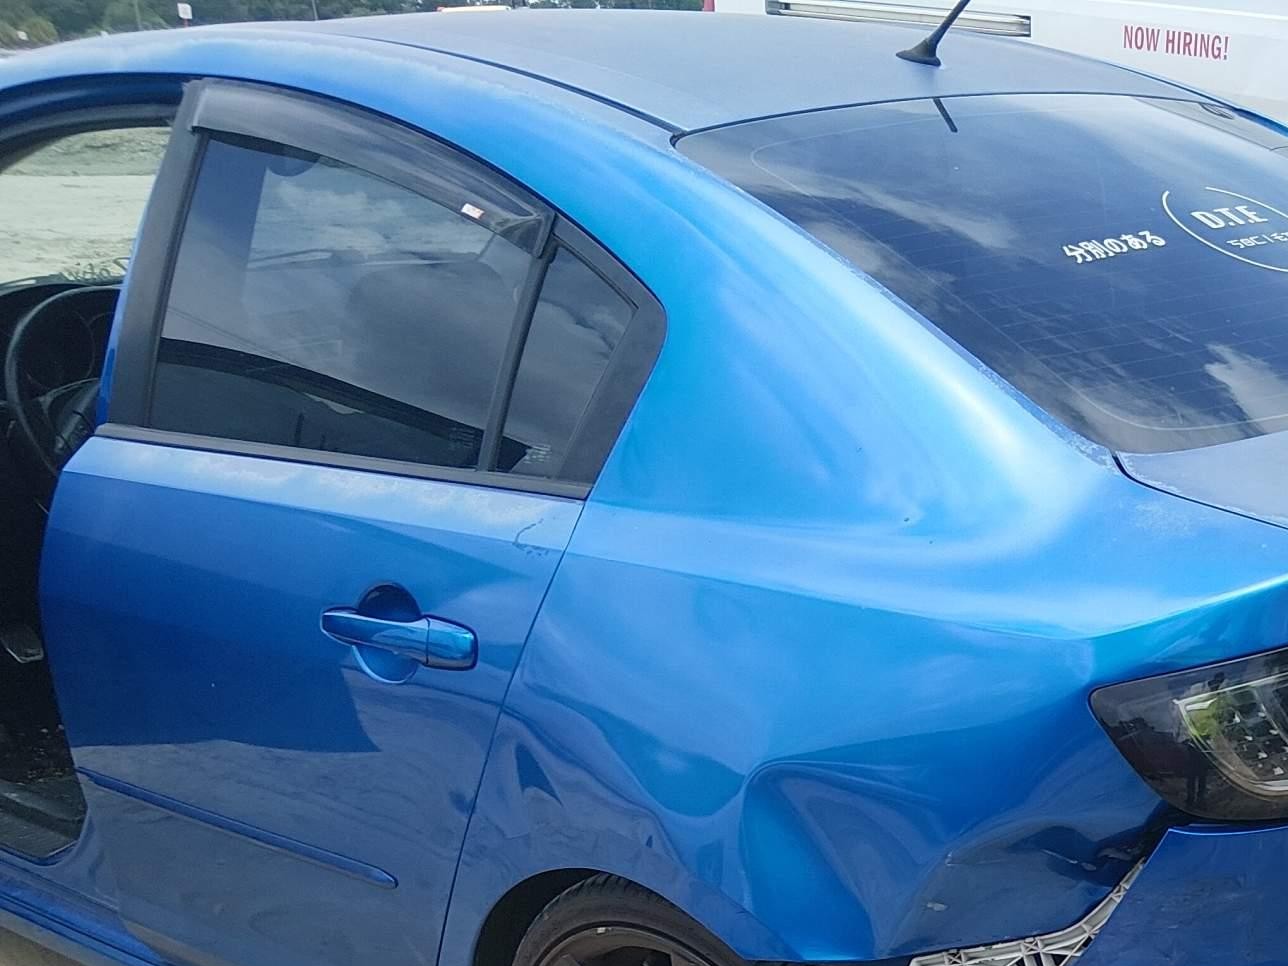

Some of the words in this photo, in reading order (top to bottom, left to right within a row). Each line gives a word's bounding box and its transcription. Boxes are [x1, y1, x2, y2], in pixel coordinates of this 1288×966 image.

[1123, 25, 1161, 52] NOW
[1165, 29, 1229, 60] HIRING!
[1062, 231, 1167, 264] 分別のある
